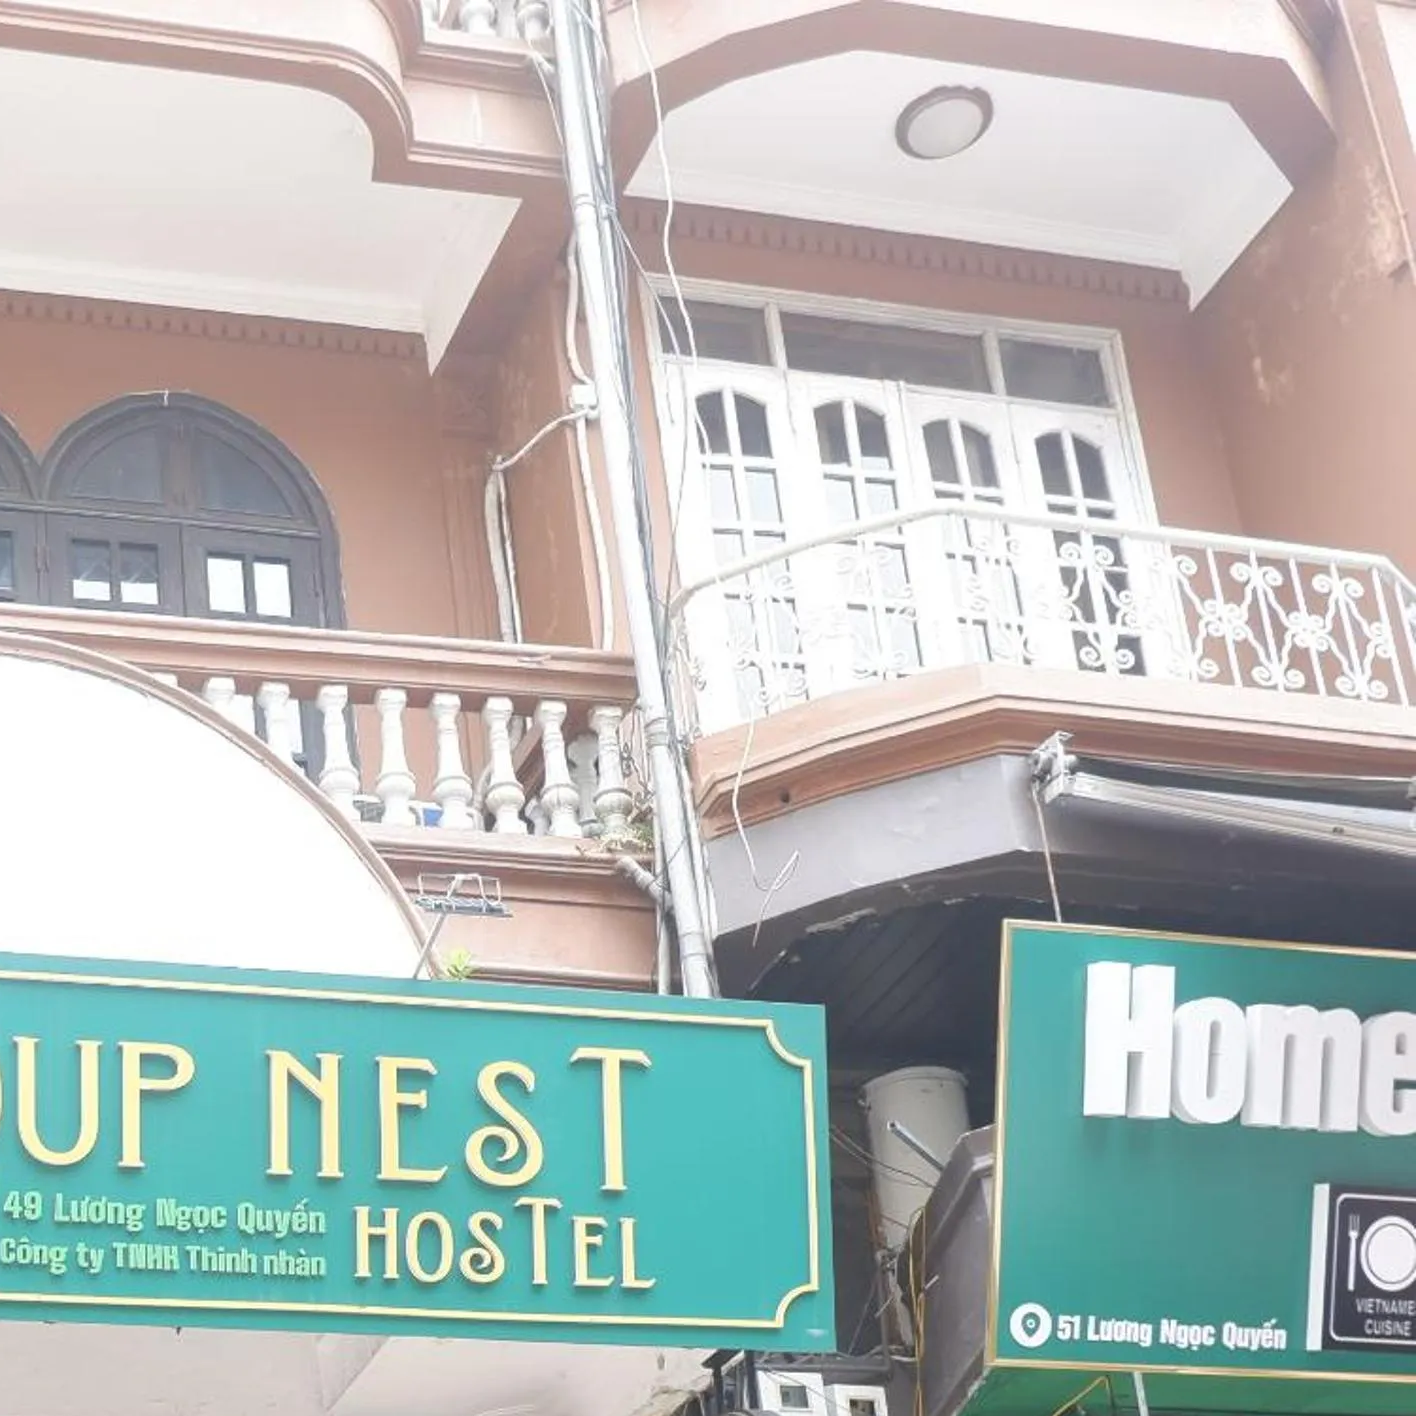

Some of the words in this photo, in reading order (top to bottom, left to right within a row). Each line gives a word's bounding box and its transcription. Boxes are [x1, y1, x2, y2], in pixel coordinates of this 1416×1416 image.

[1084, 960, 1416, 1136] Home
[265, 1047, 652, 1191] NEST
[4, 1191, 42, 1220] 49
[54, 1193, 146, 1232] Lương
[156, 1198, 227, 1233] Ngọc
[237, 1198, 326, 1238] Quyến
[0, 1236, 67, 1274] Công
[76, 1242, 104, 1273] ty
[112, 1242, 180, 1270] TNHH
[354, 1197, 655, 1289] HOSTEL
[1057, 1315, 1081, 1341] 51
[1087, 1315, 1152, 1347] Lương
[1160, 1319, 1215, 1351] Ngọc
[1222, 1318, 1287, 1350] Quyến
[1364, 1319, 1412, 1337] CUISINE
